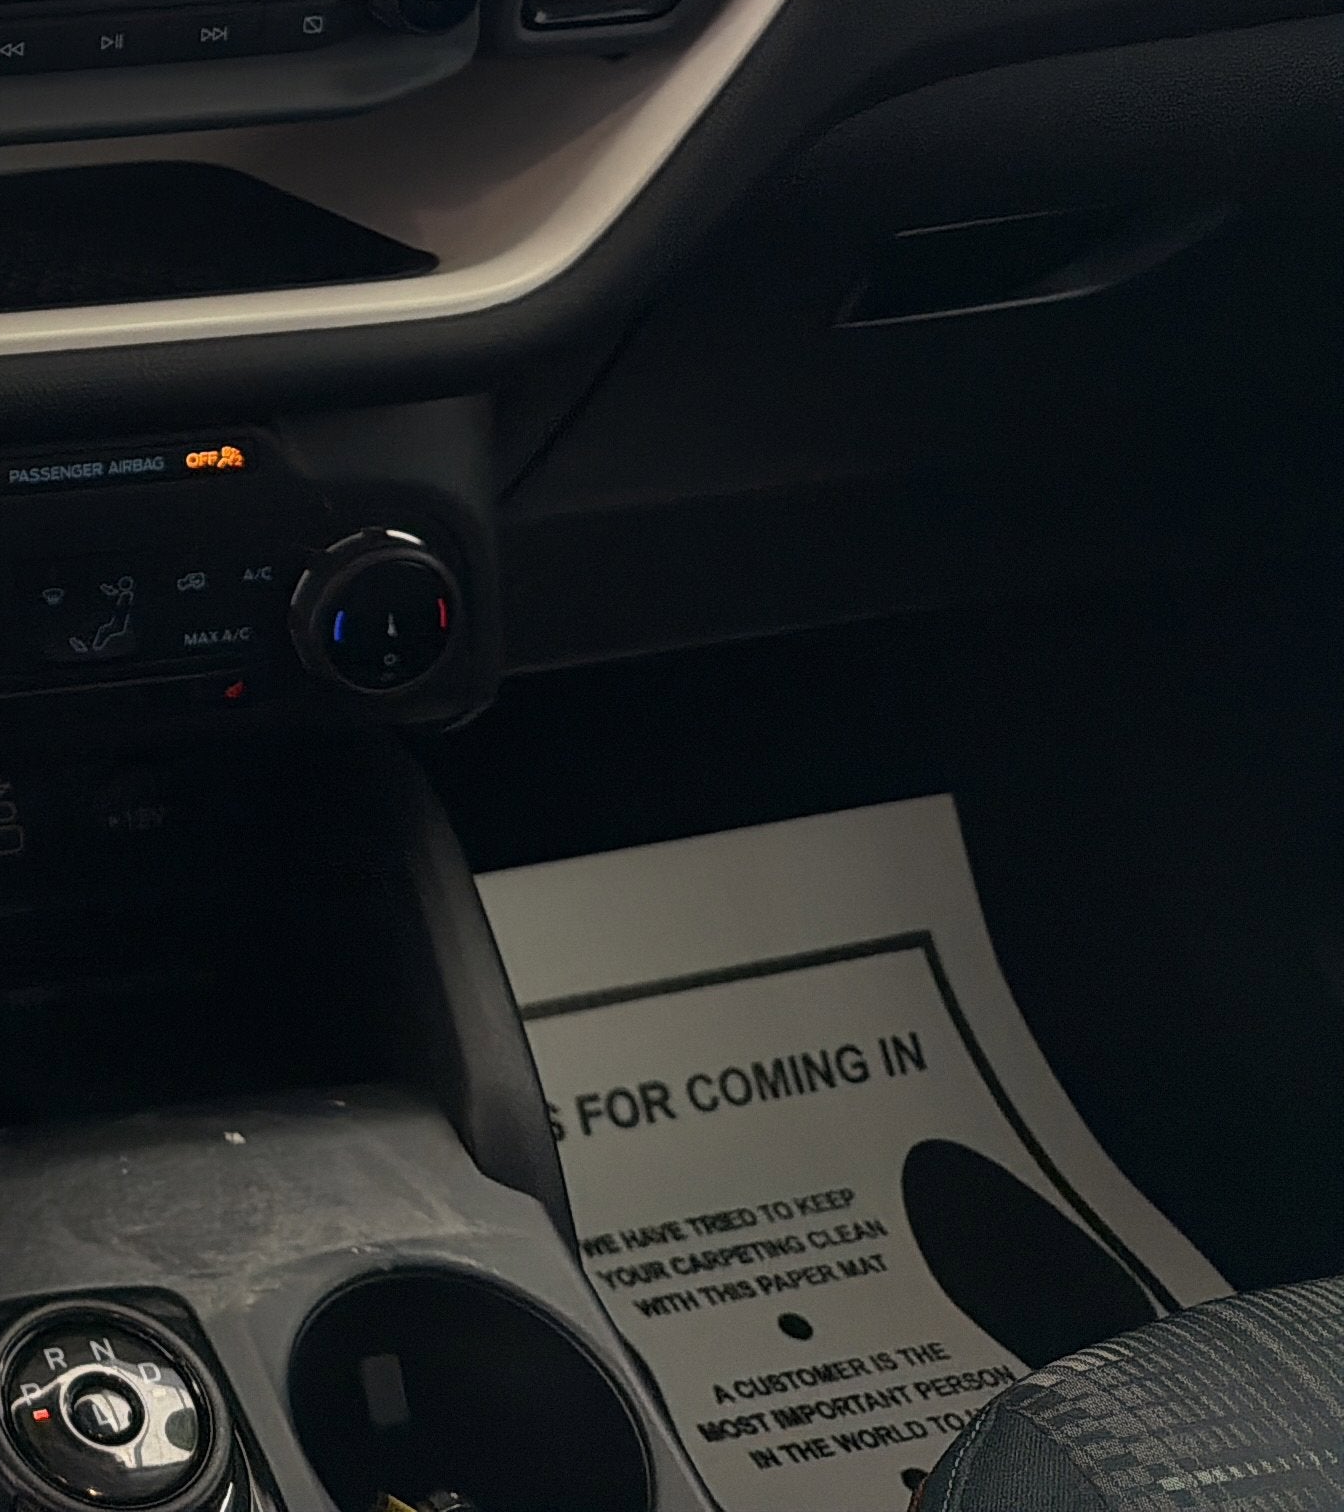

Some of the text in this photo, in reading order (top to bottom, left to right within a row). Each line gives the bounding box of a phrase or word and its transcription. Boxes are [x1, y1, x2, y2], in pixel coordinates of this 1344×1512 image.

[8, 451, 218, 485] PASSENGER AIRBAG OFF
[243, 566, 273, 582] A/C
[184, 627, 252, 647] MAX A/C
[575, 1080, 677, 1137] FOR
[686, 1043, 870, 1113] COMING
[878, 1031, 927, 1077] IN
[582, 1188, 855, 1259] WE HAVE TRIED TO KEEP
[596, 1218, 888, 1289] YOUR CARPETING CLEAN
[633, 1253, 888, 1318] WITH THIS PAPER MAT
[20, 1338, 163, 1407] P R N D
[696, 1364, 1018, 1442] MOST IMPORTANT PERSON
[713, 1341, 952, 1406] A CUSTOMER IS THE
[748, 1448, 782, 1471] IN
[777, 1437, 835, 1466] THE
[831, 1419, 928, 1454] WORLD
[926, 1410, 964, 1435] TO
